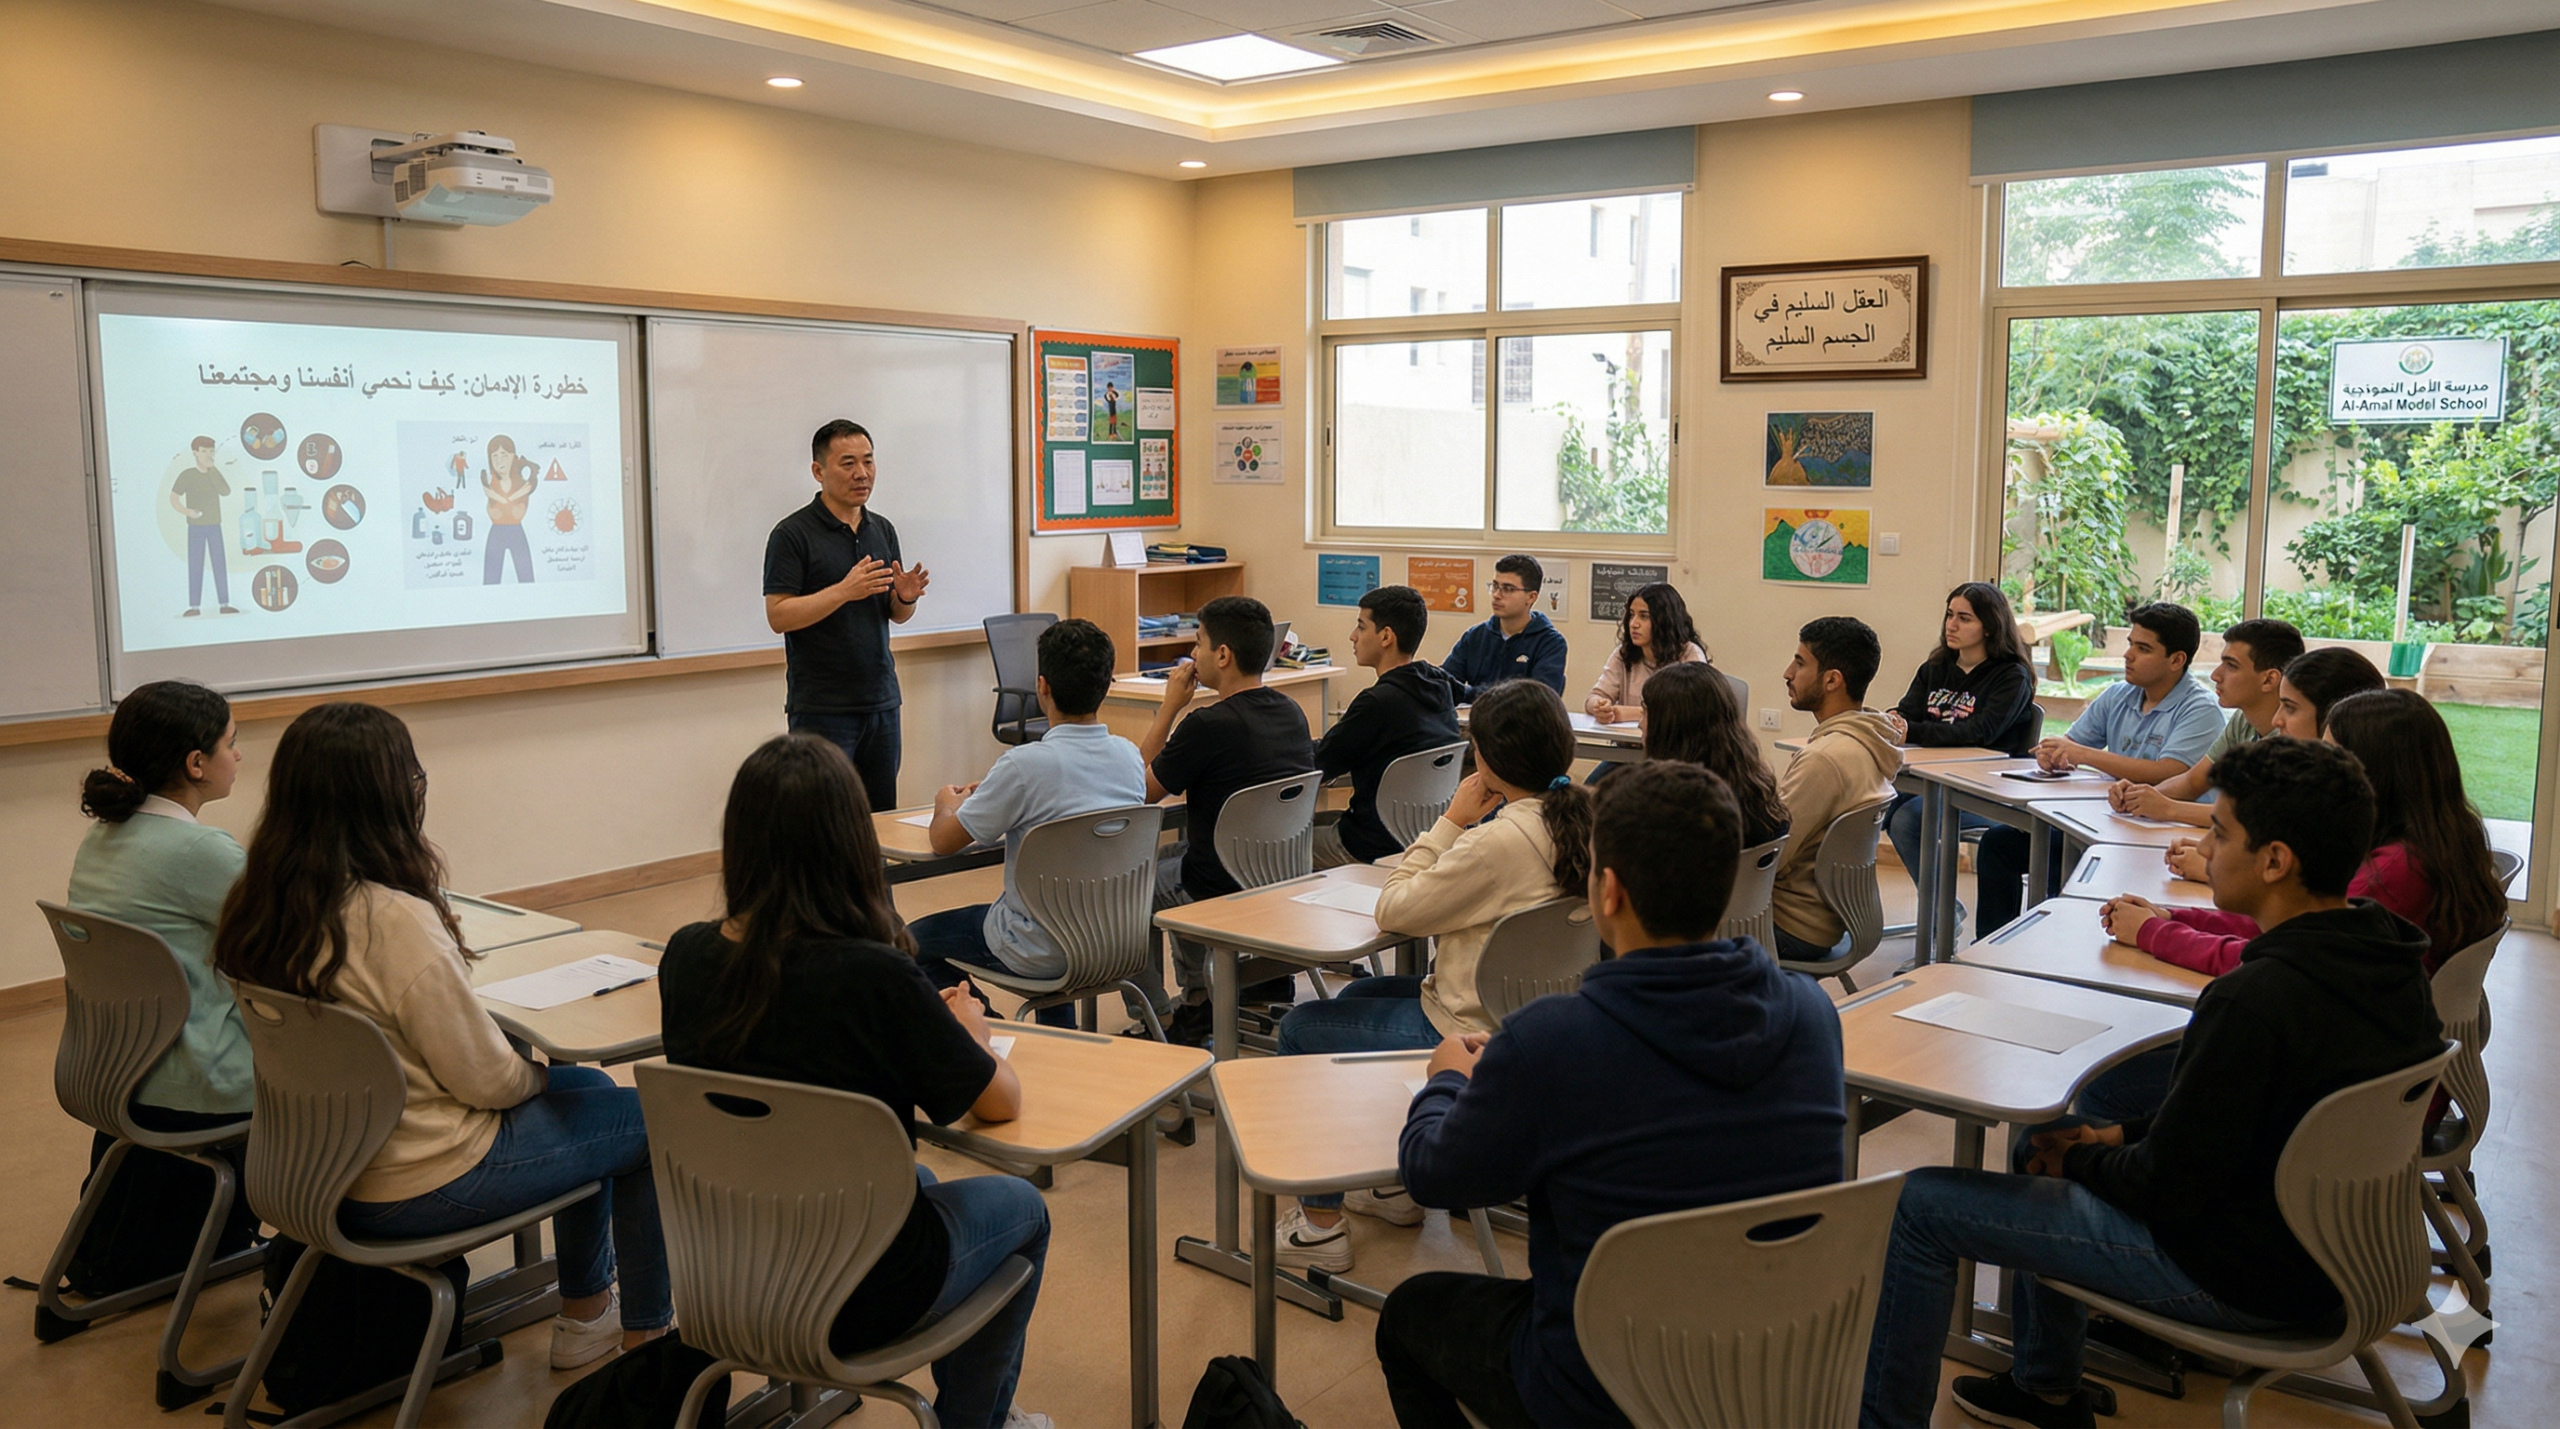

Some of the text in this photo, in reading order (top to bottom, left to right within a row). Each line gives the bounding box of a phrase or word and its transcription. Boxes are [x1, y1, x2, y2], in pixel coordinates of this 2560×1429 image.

[1754, 288, 1889, 323] العقل السليم في
[1765, 322, 1876, 355] الجسم السليم
[198, 363, 588, 400] خطورة الإدمان: كيف نحمي أنفسنا ومجتمعنا
[2407, 378, 2441, 396] الأمل
[2444, 380, 2489, 395] مدرسة
[2341, 398, 2393, 411] Al-Amal
[2440, 397, 2488, 410] School
